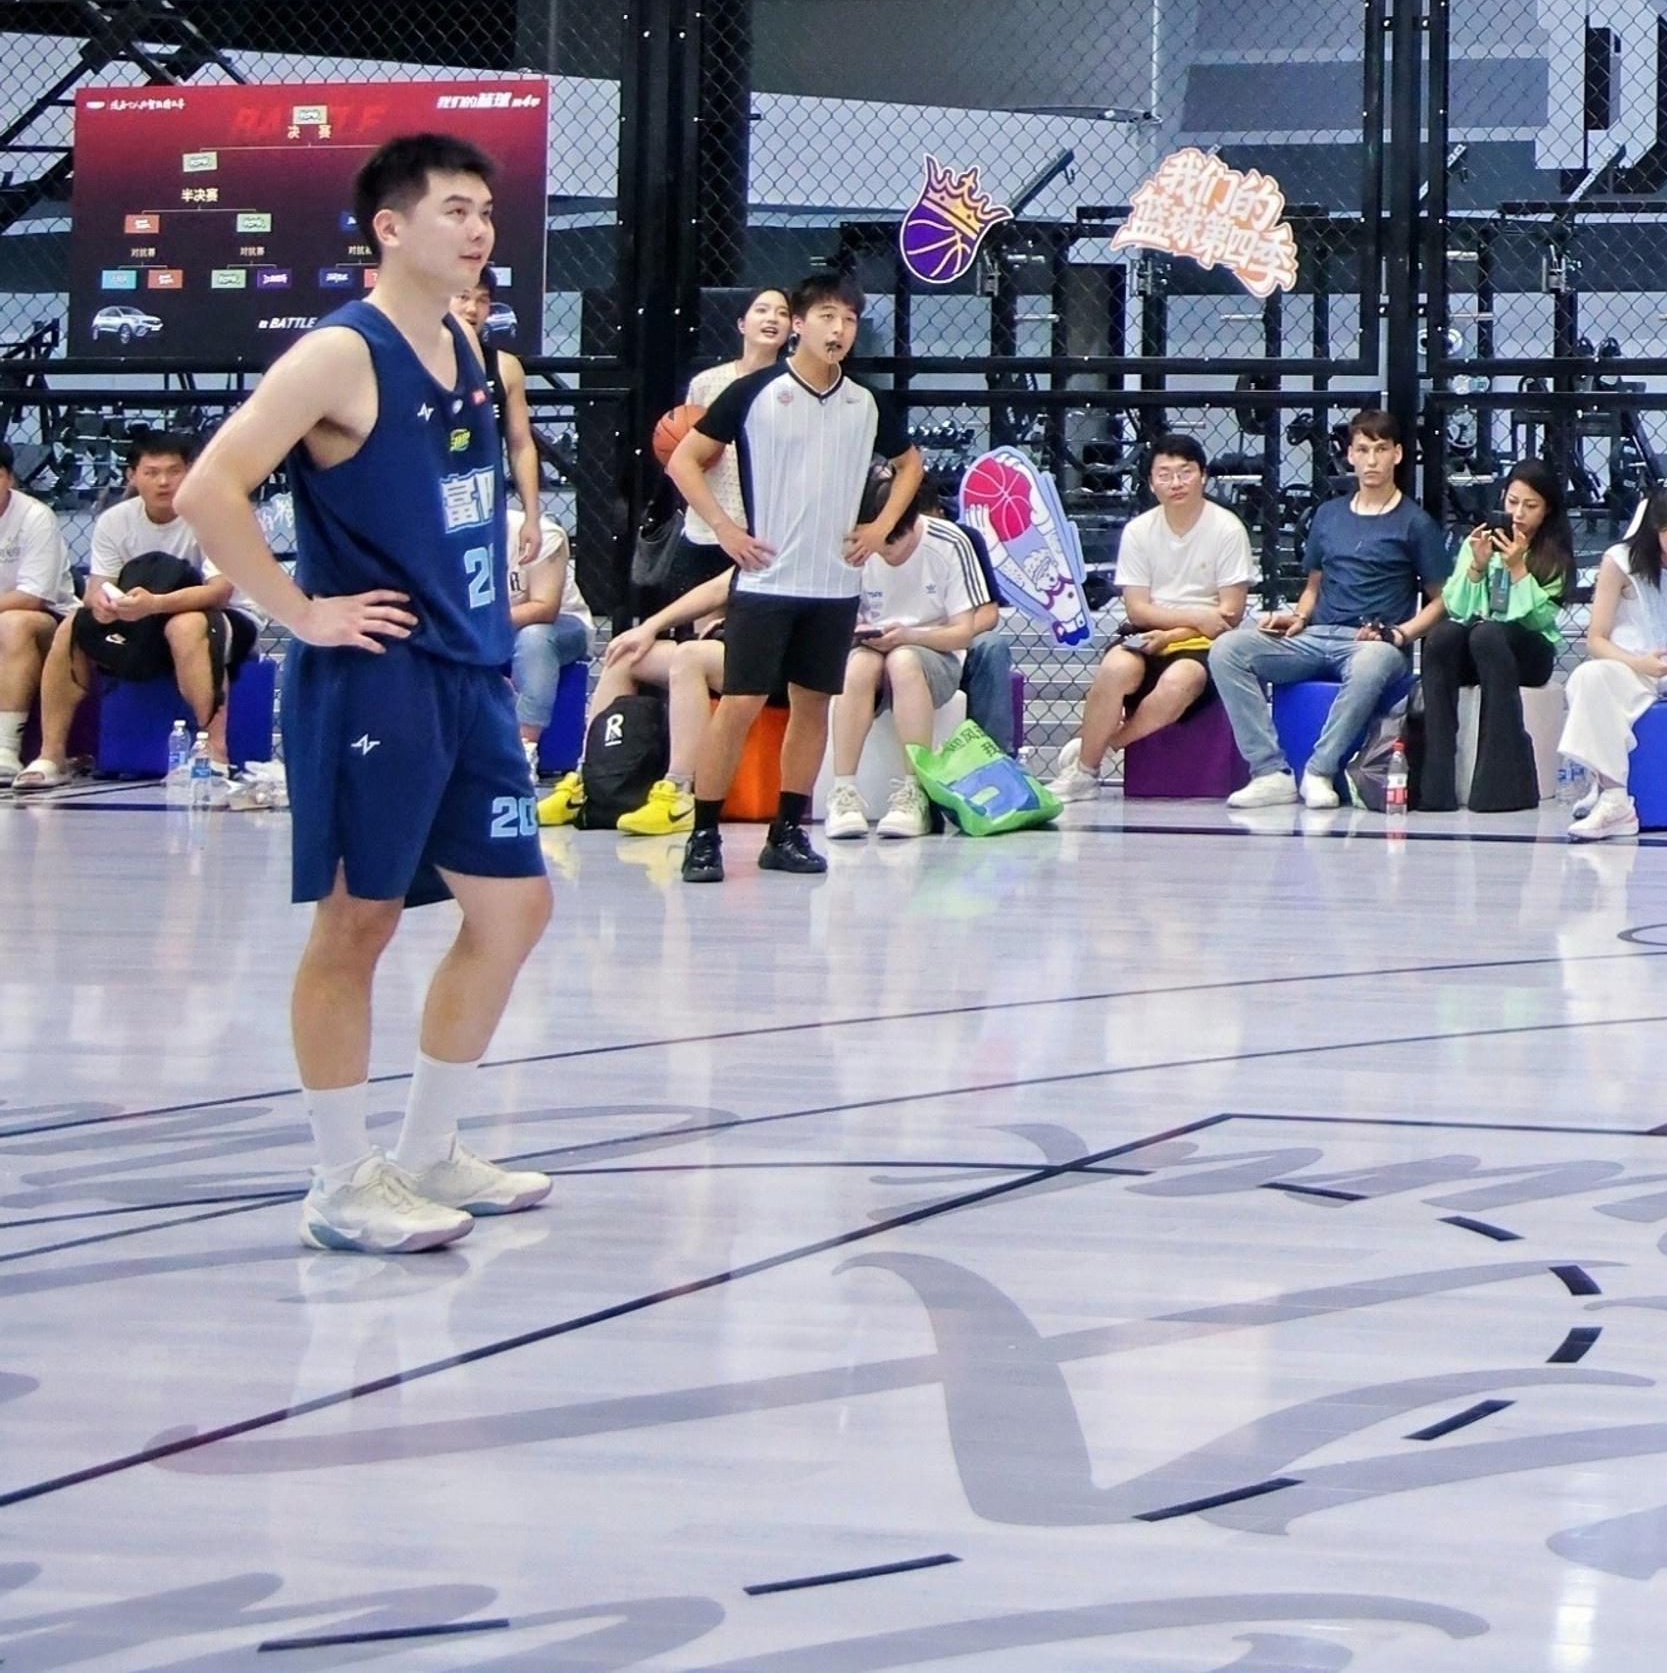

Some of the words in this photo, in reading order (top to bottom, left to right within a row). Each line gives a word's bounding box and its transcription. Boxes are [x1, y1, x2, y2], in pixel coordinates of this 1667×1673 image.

[181, 187, 219, 203] 半决赛
[1158, 150, 1284, 233] 我们的
[1111, 184, 1298, 298] 篮球第四季
[490, 796, 538, 838] 20
